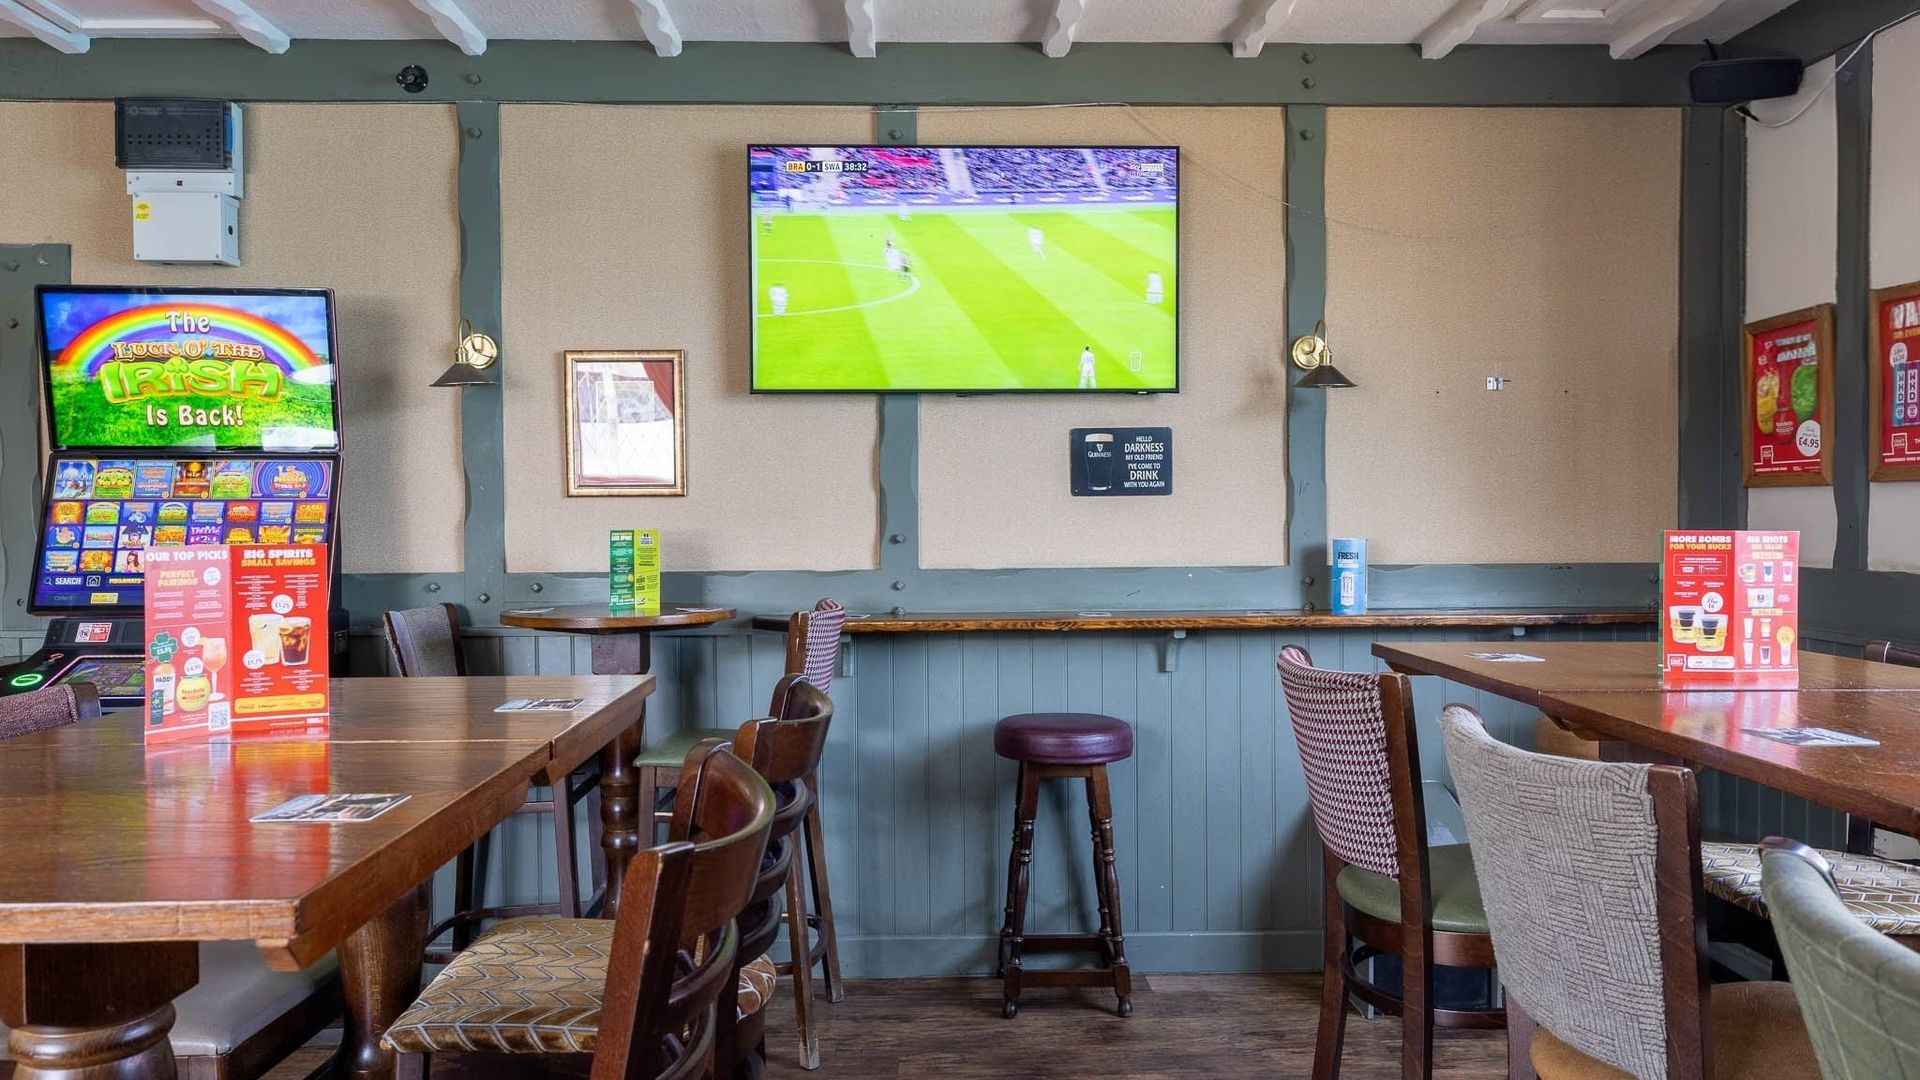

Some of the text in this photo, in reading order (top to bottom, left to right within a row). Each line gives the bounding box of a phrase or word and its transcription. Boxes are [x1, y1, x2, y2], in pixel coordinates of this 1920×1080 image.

[788, 162, 867, 171] BRA 0-1 SWA 38:32
[165, 310, 210, 333] The
[112, 341, 180, 360] LUCK
[212, 342, 265, 359] THE
[101, 357, 283, 403] IRISH
[146, 404, 244, 426] Is Back!
[1798, 437, 1820, 448] £4.95
[1124, 443, 1164, 453] DARKNESS
[1130, 470, 1159, 480] DRINK
[1669, 535, 1732, 543] MORE BOMBS
[146, 550, 228, 561] OUR TOP PICKS
[243, 548, 314, 559] BIG SPIRITS
[1337, 551, 1359, 560] FRESH
[241, 558, 317, 567] SMALL SAVINGS
[160, 570, 195, 579] PERFECT
[54, 577, 82, 585] SEARCH
[157, 578, 198, 587] PAIRINGS
